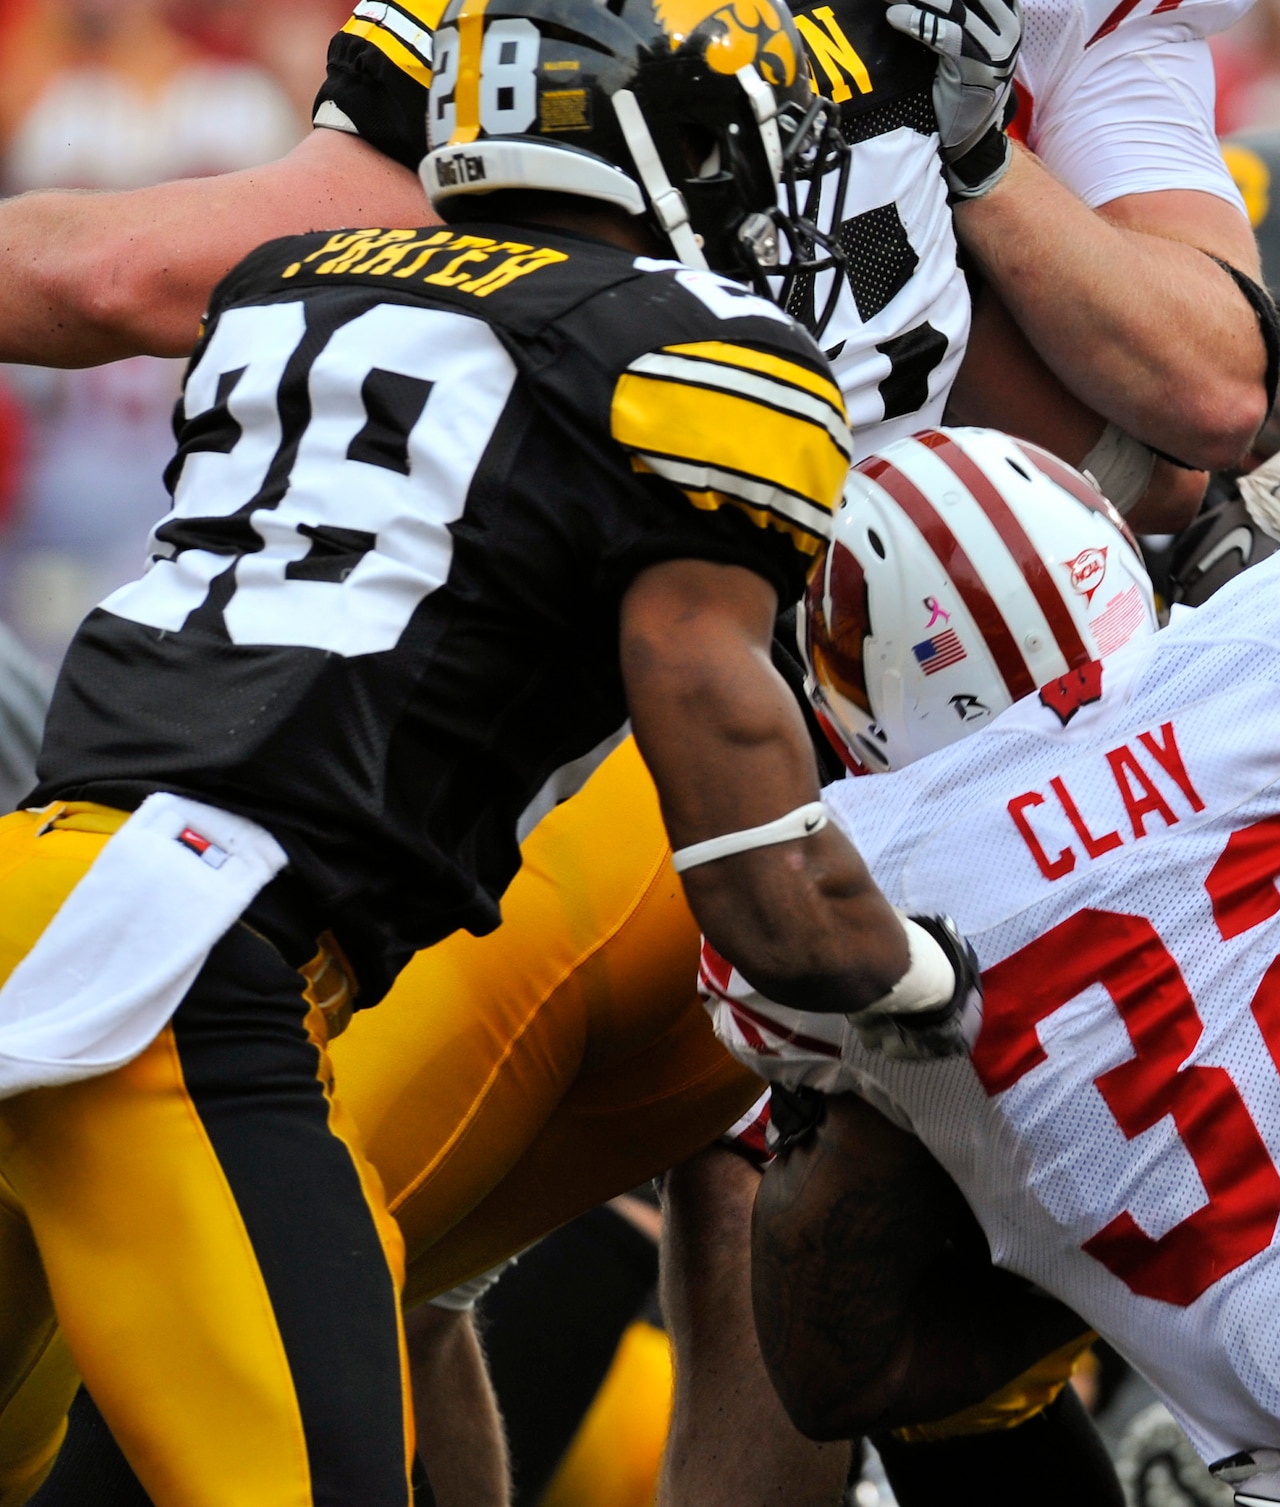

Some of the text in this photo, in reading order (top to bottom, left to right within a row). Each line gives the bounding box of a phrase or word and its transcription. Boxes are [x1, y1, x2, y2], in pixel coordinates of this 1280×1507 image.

[428, 17, 541, 149] 28
[281, 228, 570, 298] PRATER
[98, 300, 518, 658] 28
[1006, 720, 1206, 882] CLAY
